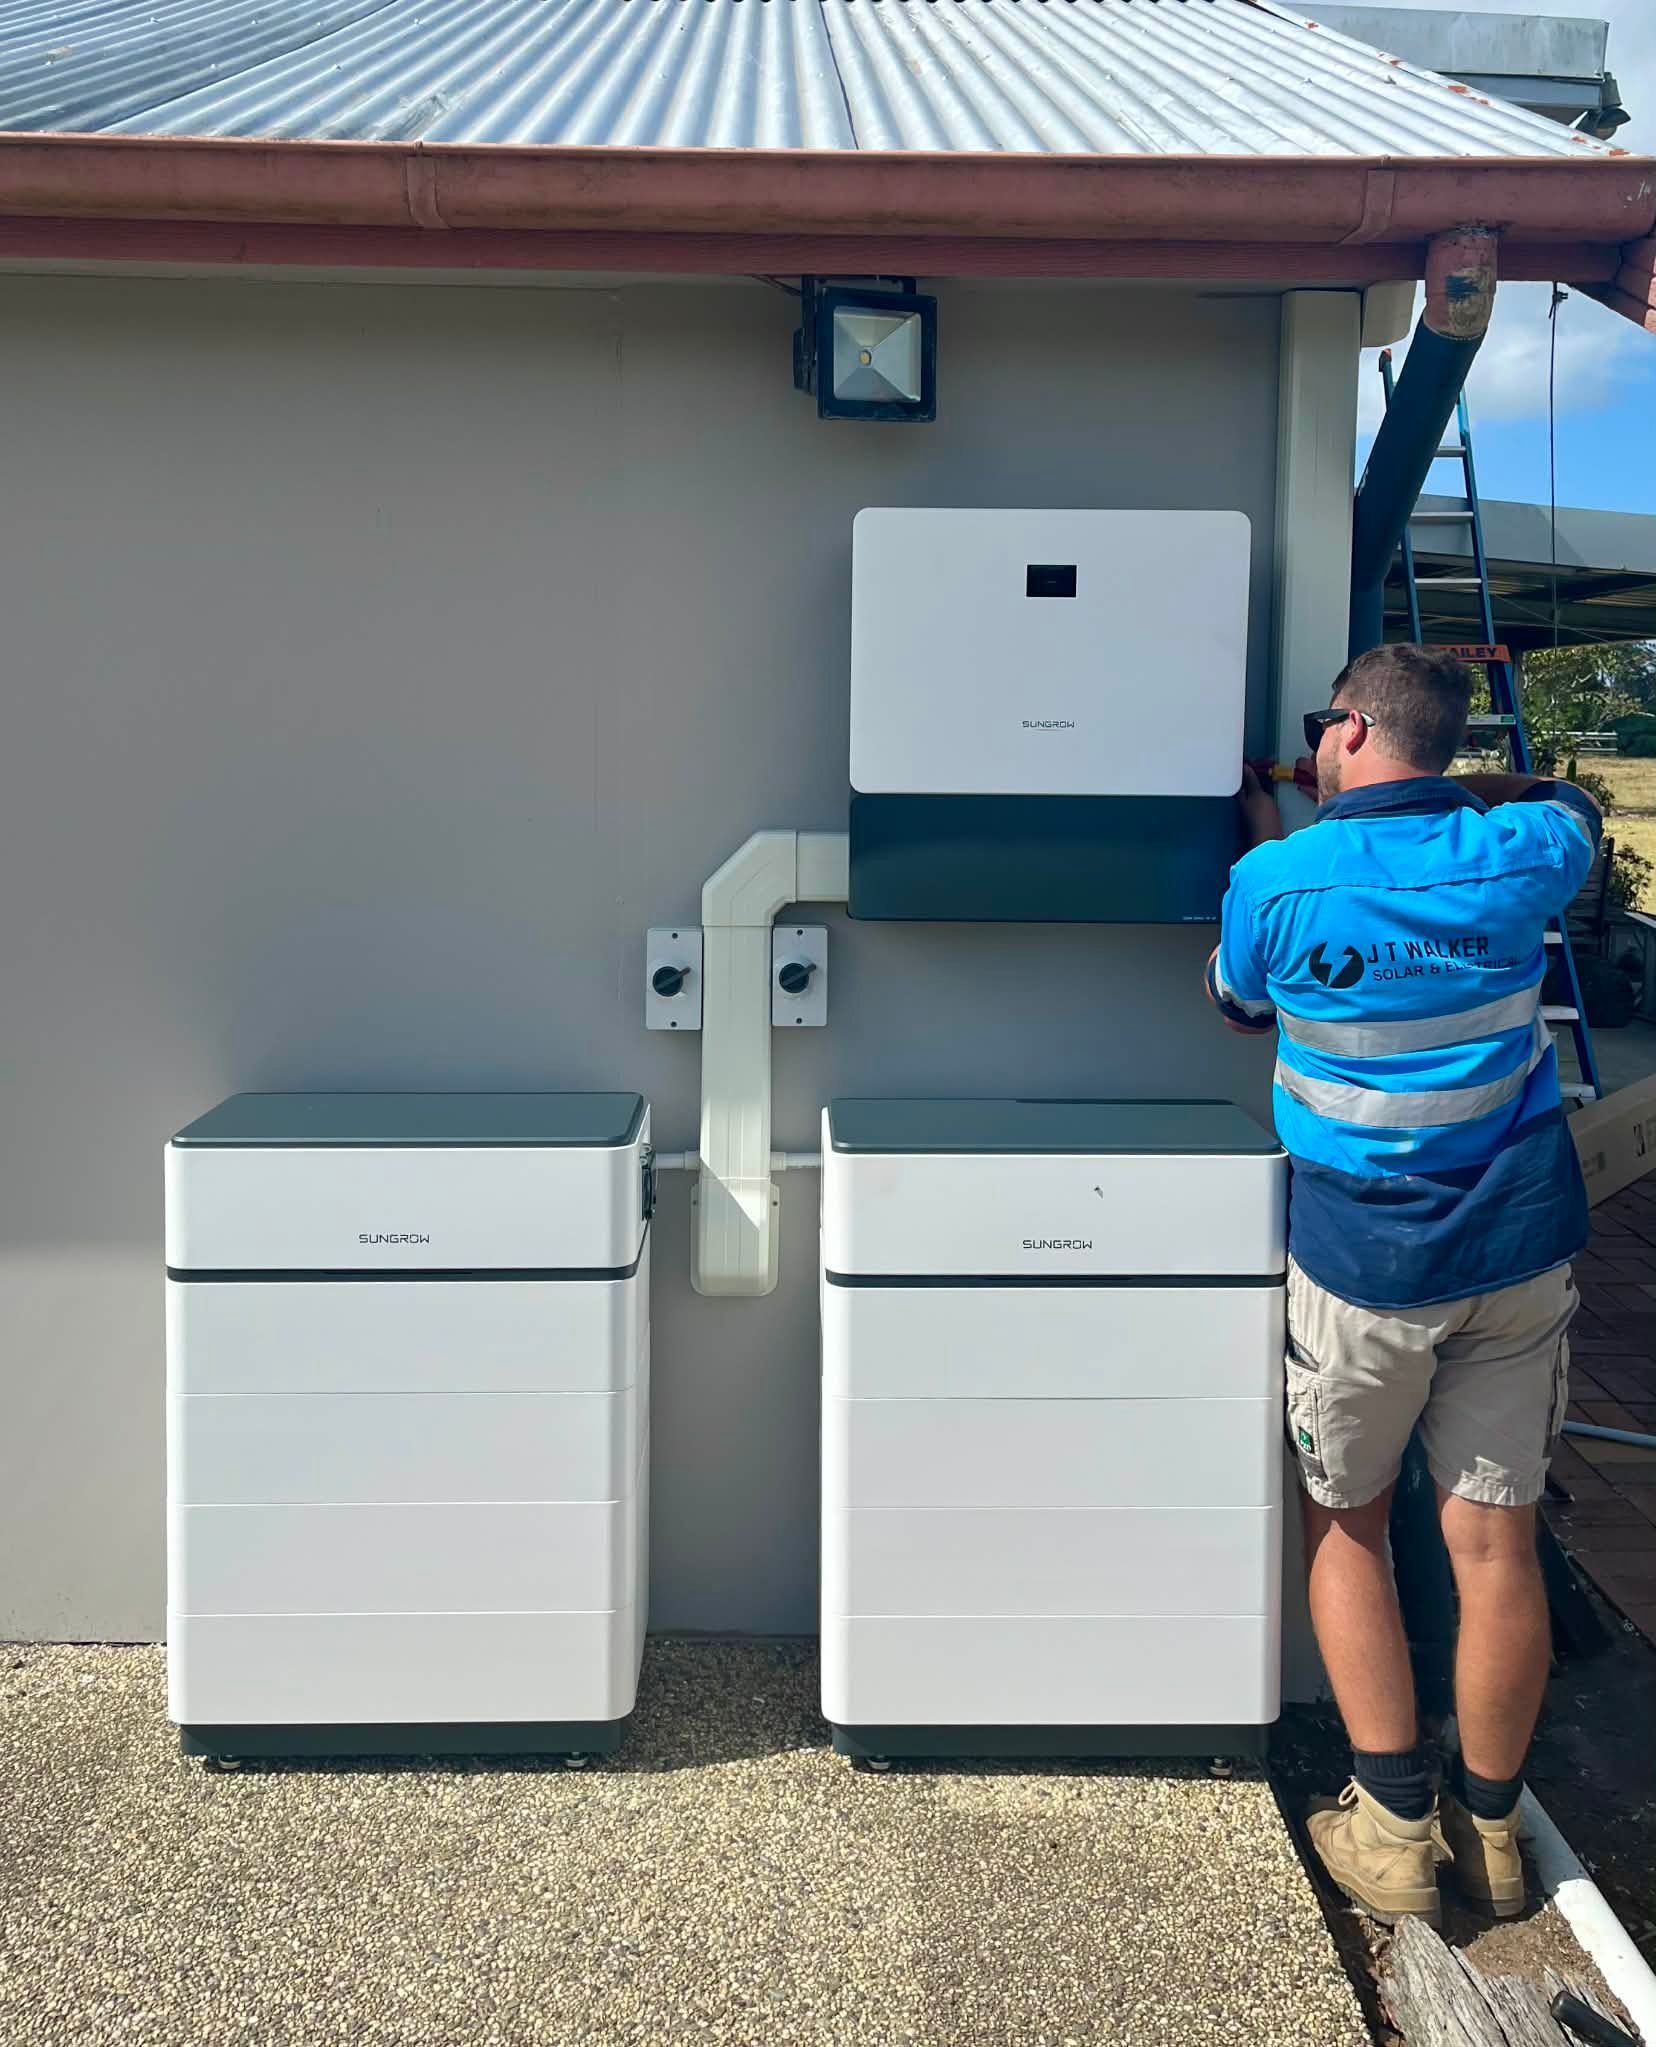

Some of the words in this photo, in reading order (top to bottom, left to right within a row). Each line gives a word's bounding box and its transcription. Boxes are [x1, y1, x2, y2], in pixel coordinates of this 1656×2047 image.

[1022, 720, 1075, 728] SUNGROW
[1367, 943, 1379, 963] J
[1384, 942, 1396, 961] T
[1403, 936, 1489, 960] WALKER
[1373, 965, 1424, 981] SOLAR
[1430, 963, 1440, 974] &
[359, 1233, 430, 1244] SUNGROW
[1022, 1239, 1093, 1249] SUNGROW
